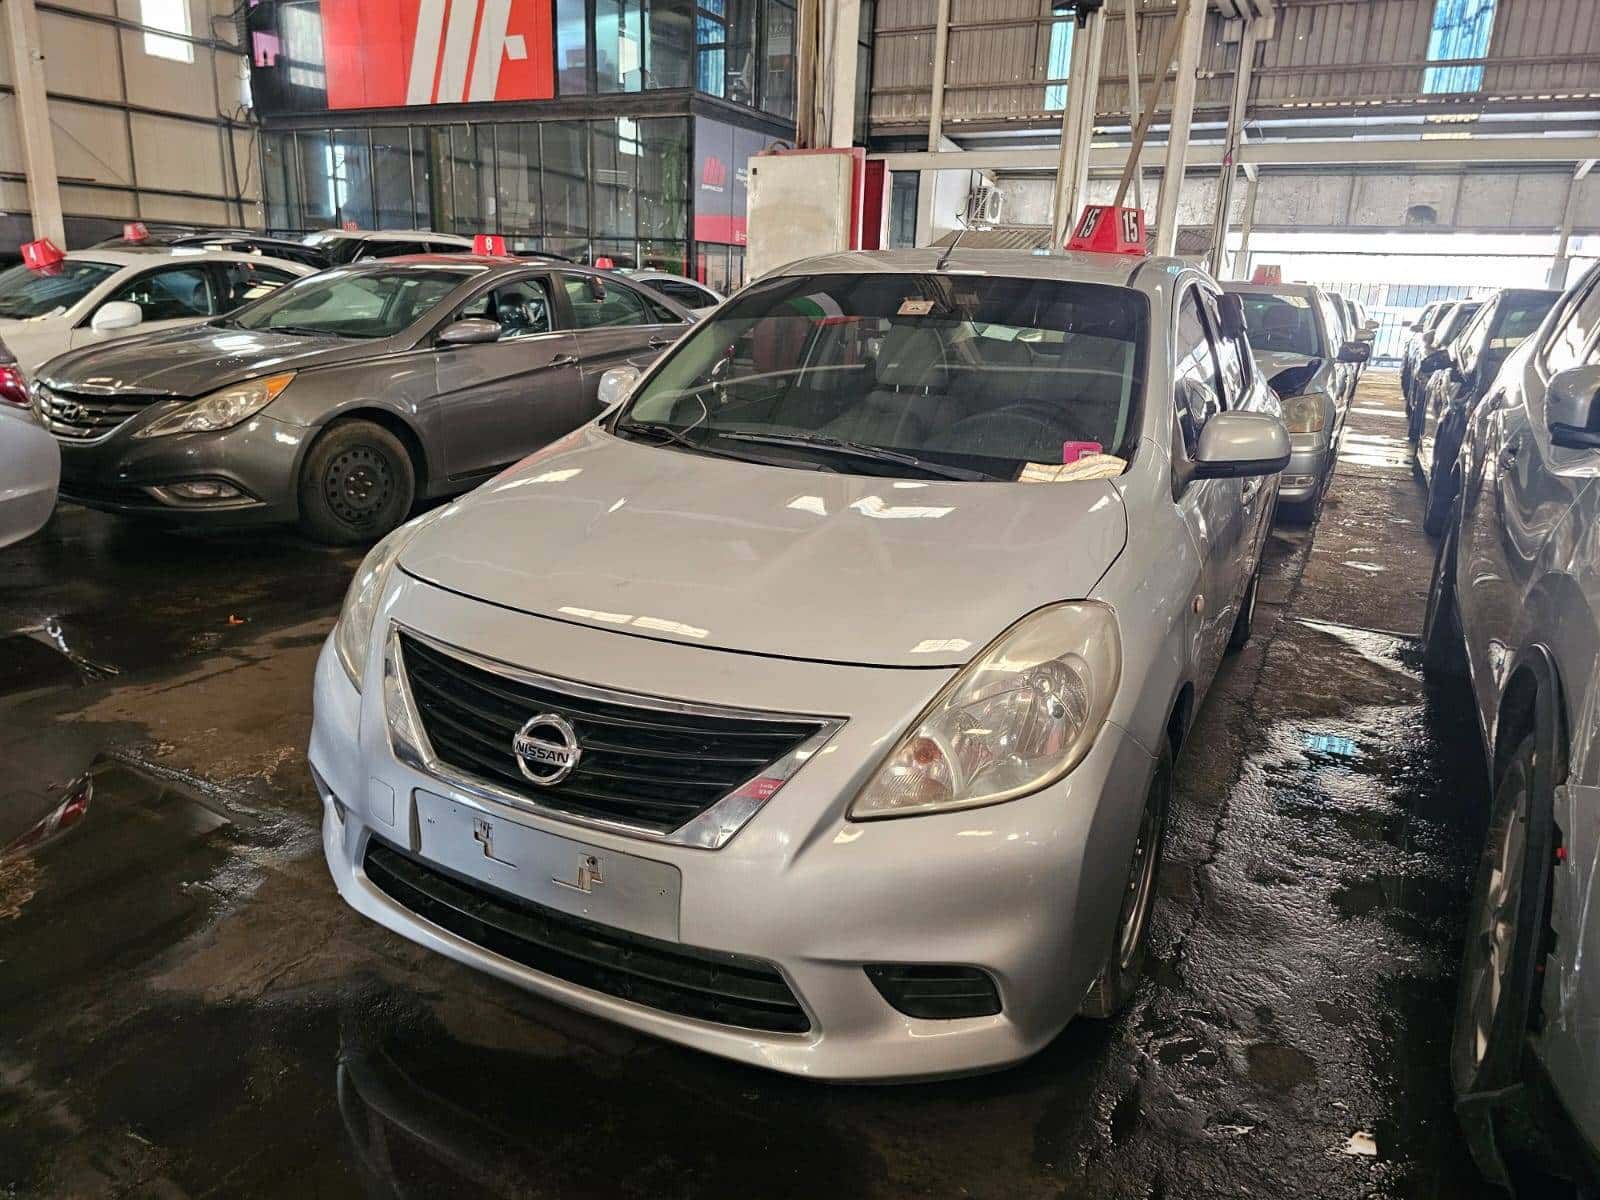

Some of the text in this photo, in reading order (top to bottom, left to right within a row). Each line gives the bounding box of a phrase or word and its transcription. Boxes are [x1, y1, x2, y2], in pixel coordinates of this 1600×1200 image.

[1079, 207, 1101, 238] 15
[1122, 210, 1138, 243] 15
[485, 235, 493, 251] 8
[516, 740, 569, 763] NISSAN
